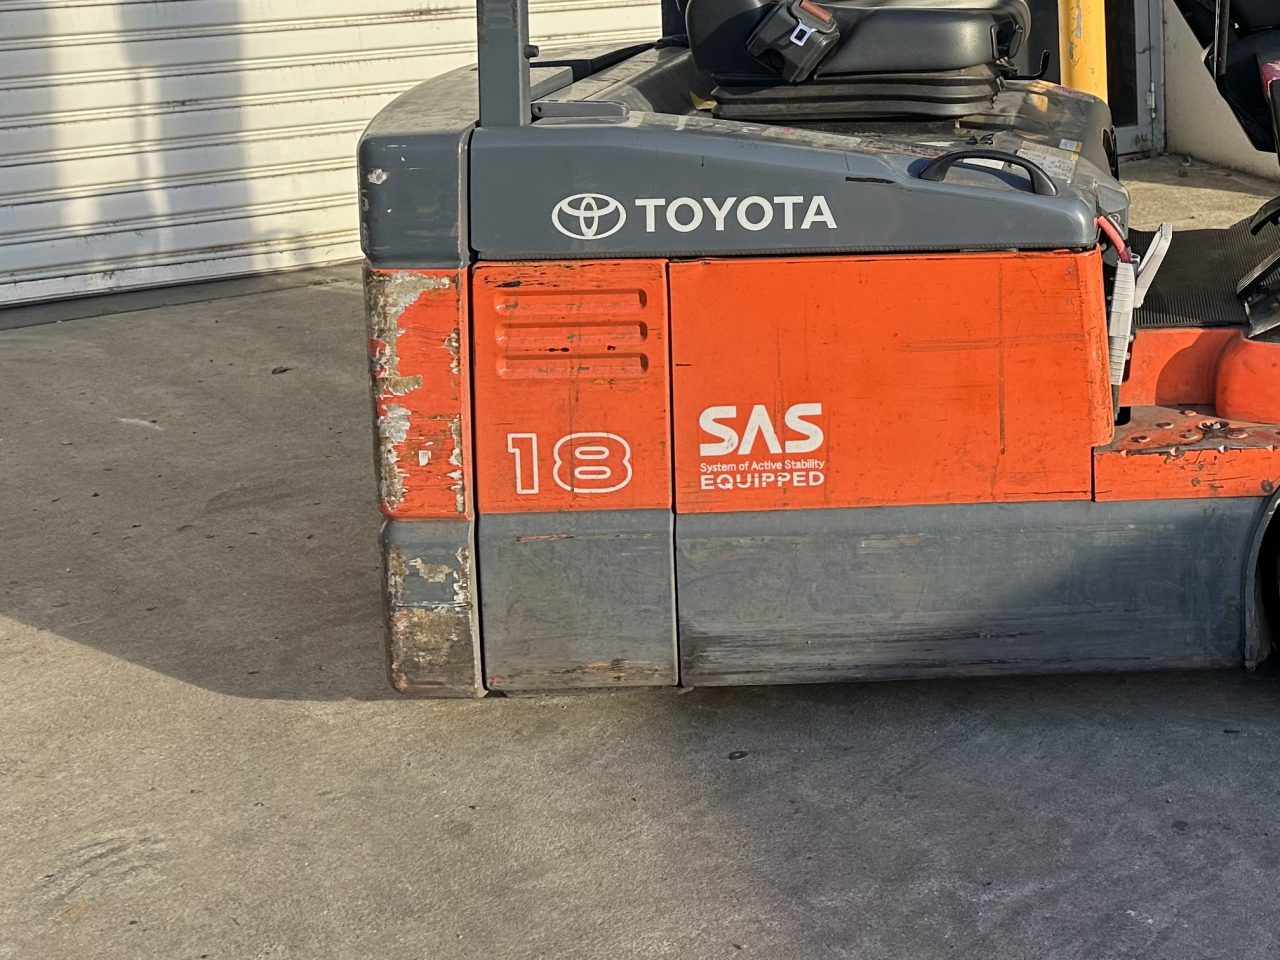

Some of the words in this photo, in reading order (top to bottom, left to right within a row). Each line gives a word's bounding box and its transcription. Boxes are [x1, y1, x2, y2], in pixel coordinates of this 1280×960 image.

[635, 195, 837, 233] TOYOTA
[699, 402, 824, 457] SAS
[507, 431, 632, 494] 18
[700, 462, 737, 473] System
[738, 461, 750, 471] of
[750, 460, 783, 470] Active
[784, 458, 825, 470] Stability
[700, 471, 825, 490] EQUIPPED
